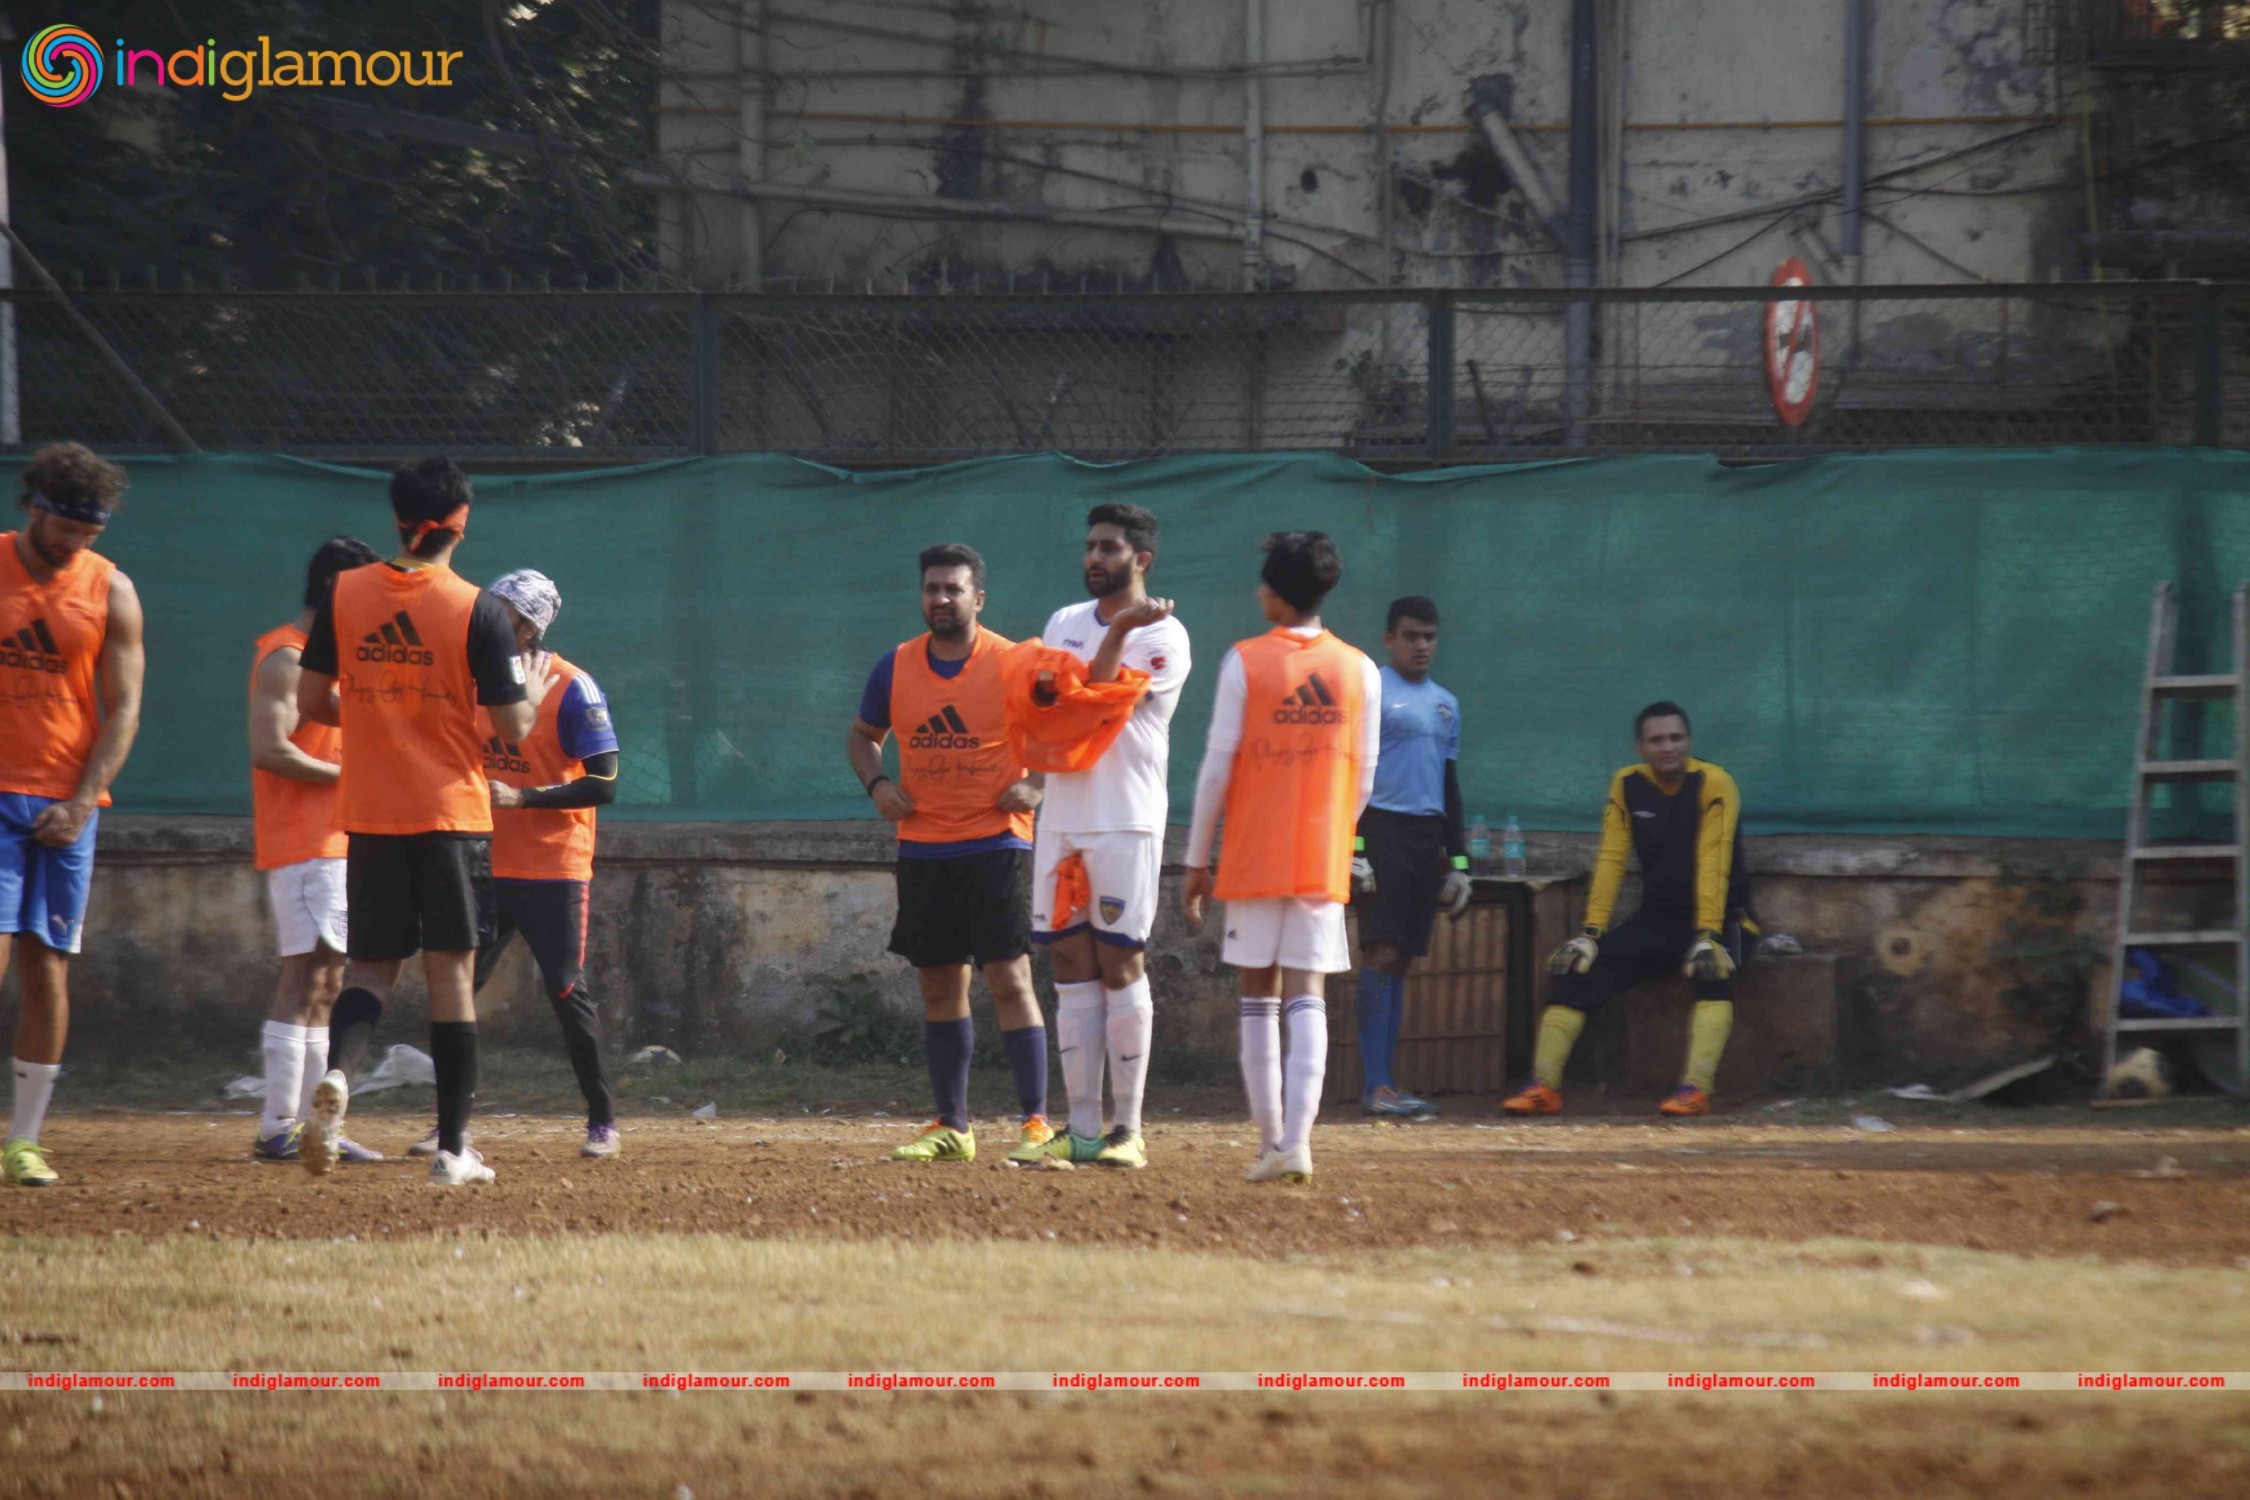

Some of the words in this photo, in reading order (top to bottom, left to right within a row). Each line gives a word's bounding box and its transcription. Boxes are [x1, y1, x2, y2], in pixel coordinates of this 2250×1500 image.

[356, 643, 434, 666] adidas
[1273, 705, 1348, 725] adidas
[909, 733, 980, 750] adidas
